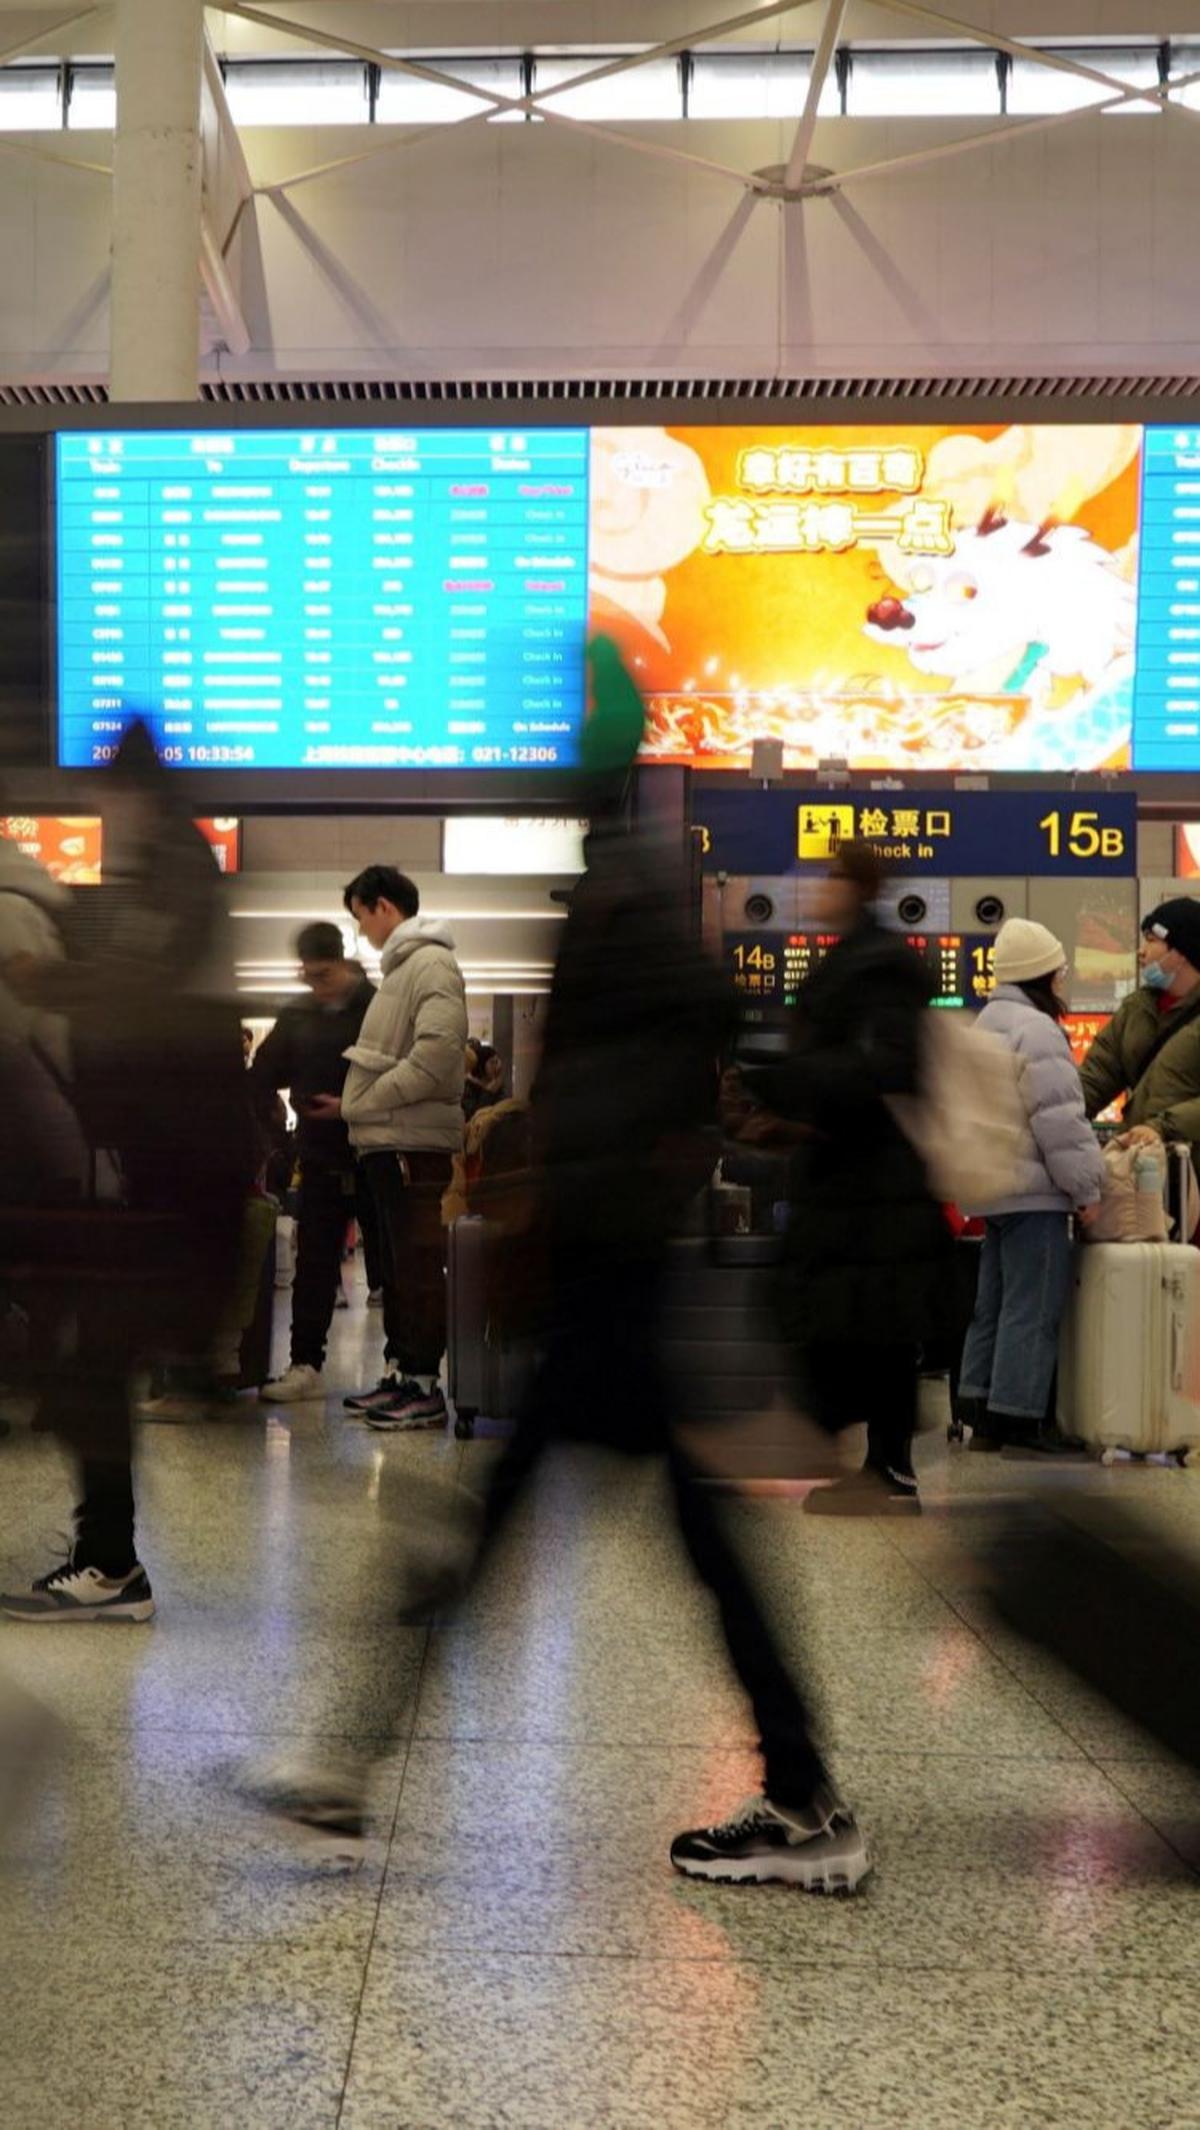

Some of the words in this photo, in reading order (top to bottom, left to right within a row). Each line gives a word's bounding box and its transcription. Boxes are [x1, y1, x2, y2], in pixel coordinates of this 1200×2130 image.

[859, 808, 950, 837] 检票口
[1040, 811, 1124, 857] 15B
[918, 843, 934, 858] in
[734, 944, 775, 970] 14B
